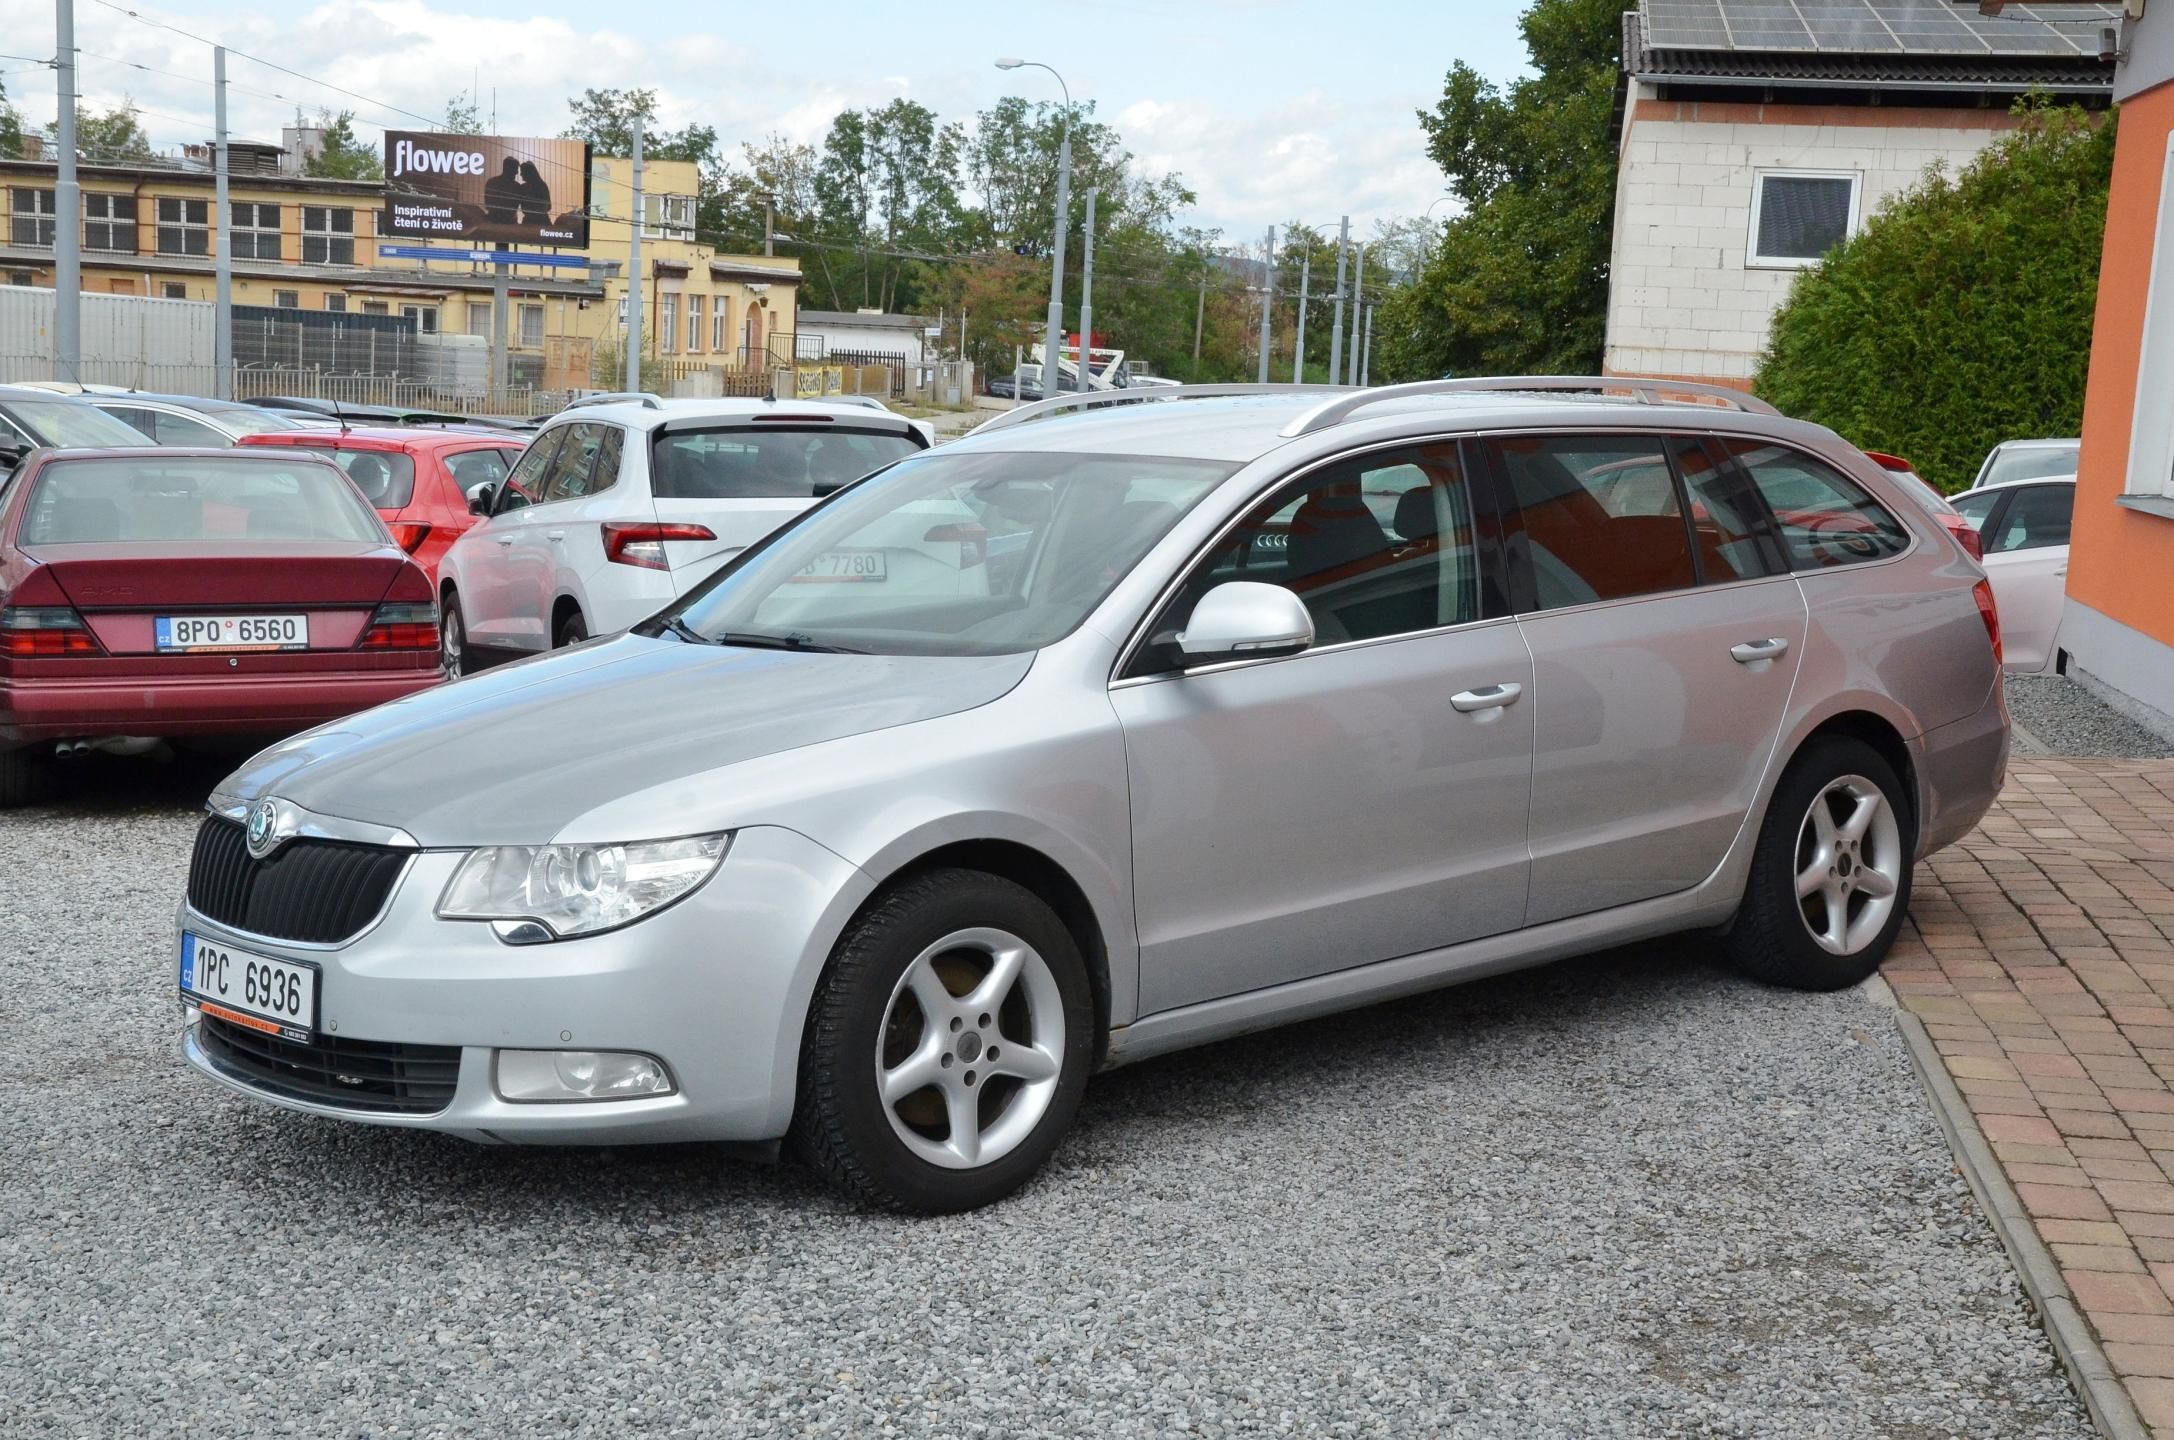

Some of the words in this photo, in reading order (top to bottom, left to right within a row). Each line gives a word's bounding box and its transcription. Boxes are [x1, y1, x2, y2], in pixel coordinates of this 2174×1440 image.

[393, 140, 485, 177] flowee
[394, 204, 453, 219] Inspirativní
[394, 216, 421, 229] čtení
[423, 221, 430, 229] o
[432, 218, 463, 231] životě
[540, 229, 574, 239] flowee.cz
[830, 555, 876, 575] 7780
[239, 618, 296, 641] 6560
[183, 969, 192, 983] CZ
[198, 946, 230, 995] 1PC
[245, 961, 301, 1016] 6936
